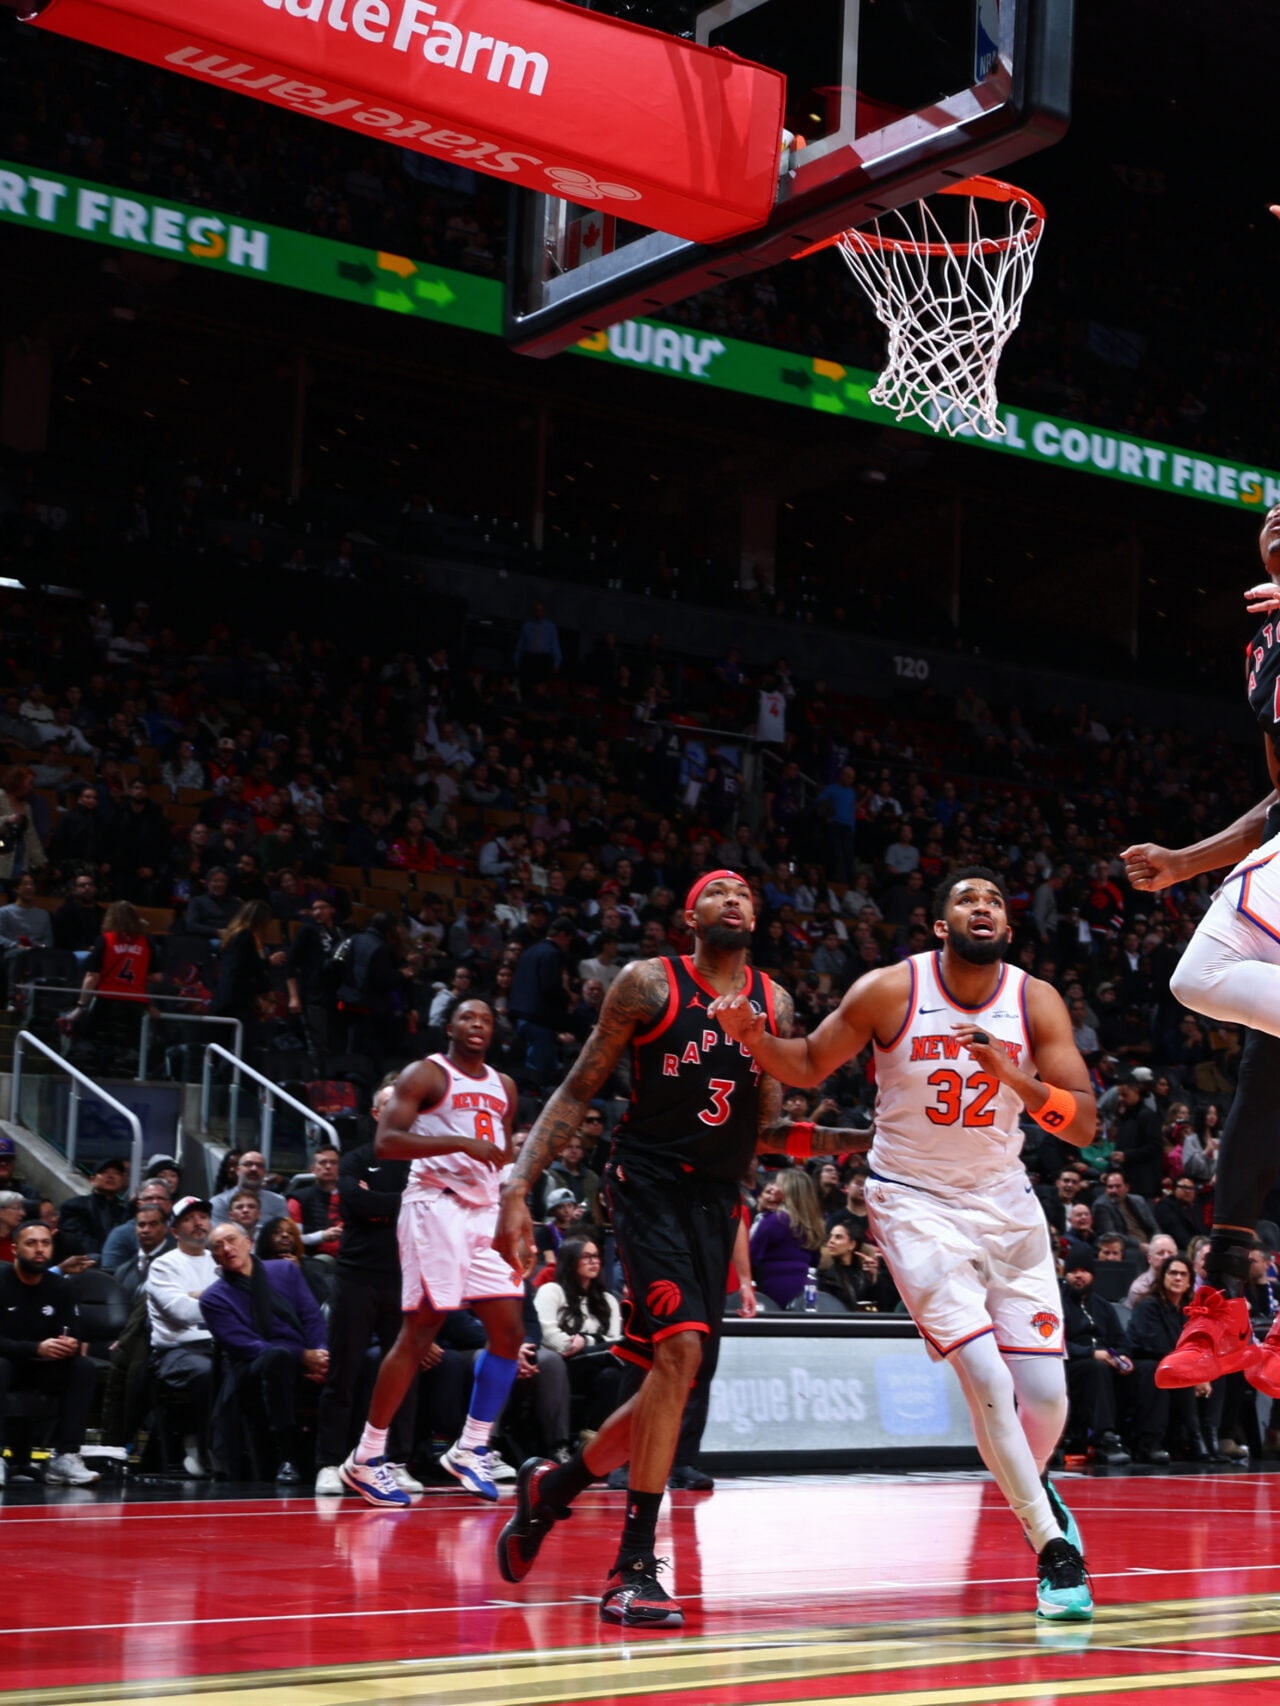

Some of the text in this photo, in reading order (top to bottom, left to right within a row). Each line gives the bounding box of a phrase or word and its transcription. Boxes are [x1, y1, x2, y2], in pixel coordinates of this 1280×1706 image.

[164, 46, 543, 173] StateFarm
[76, 187, 270, 272] FRESH
[1033, 420, 1167, 482] COURT
[893, 655, 930, 680] 120
[909, 1034, 961, 1062] NEW
[698, 1078, 736, 1127] 3
[925, 1068, 1000, 1128] 32
[790, 1366, 867, 1422] Pass
